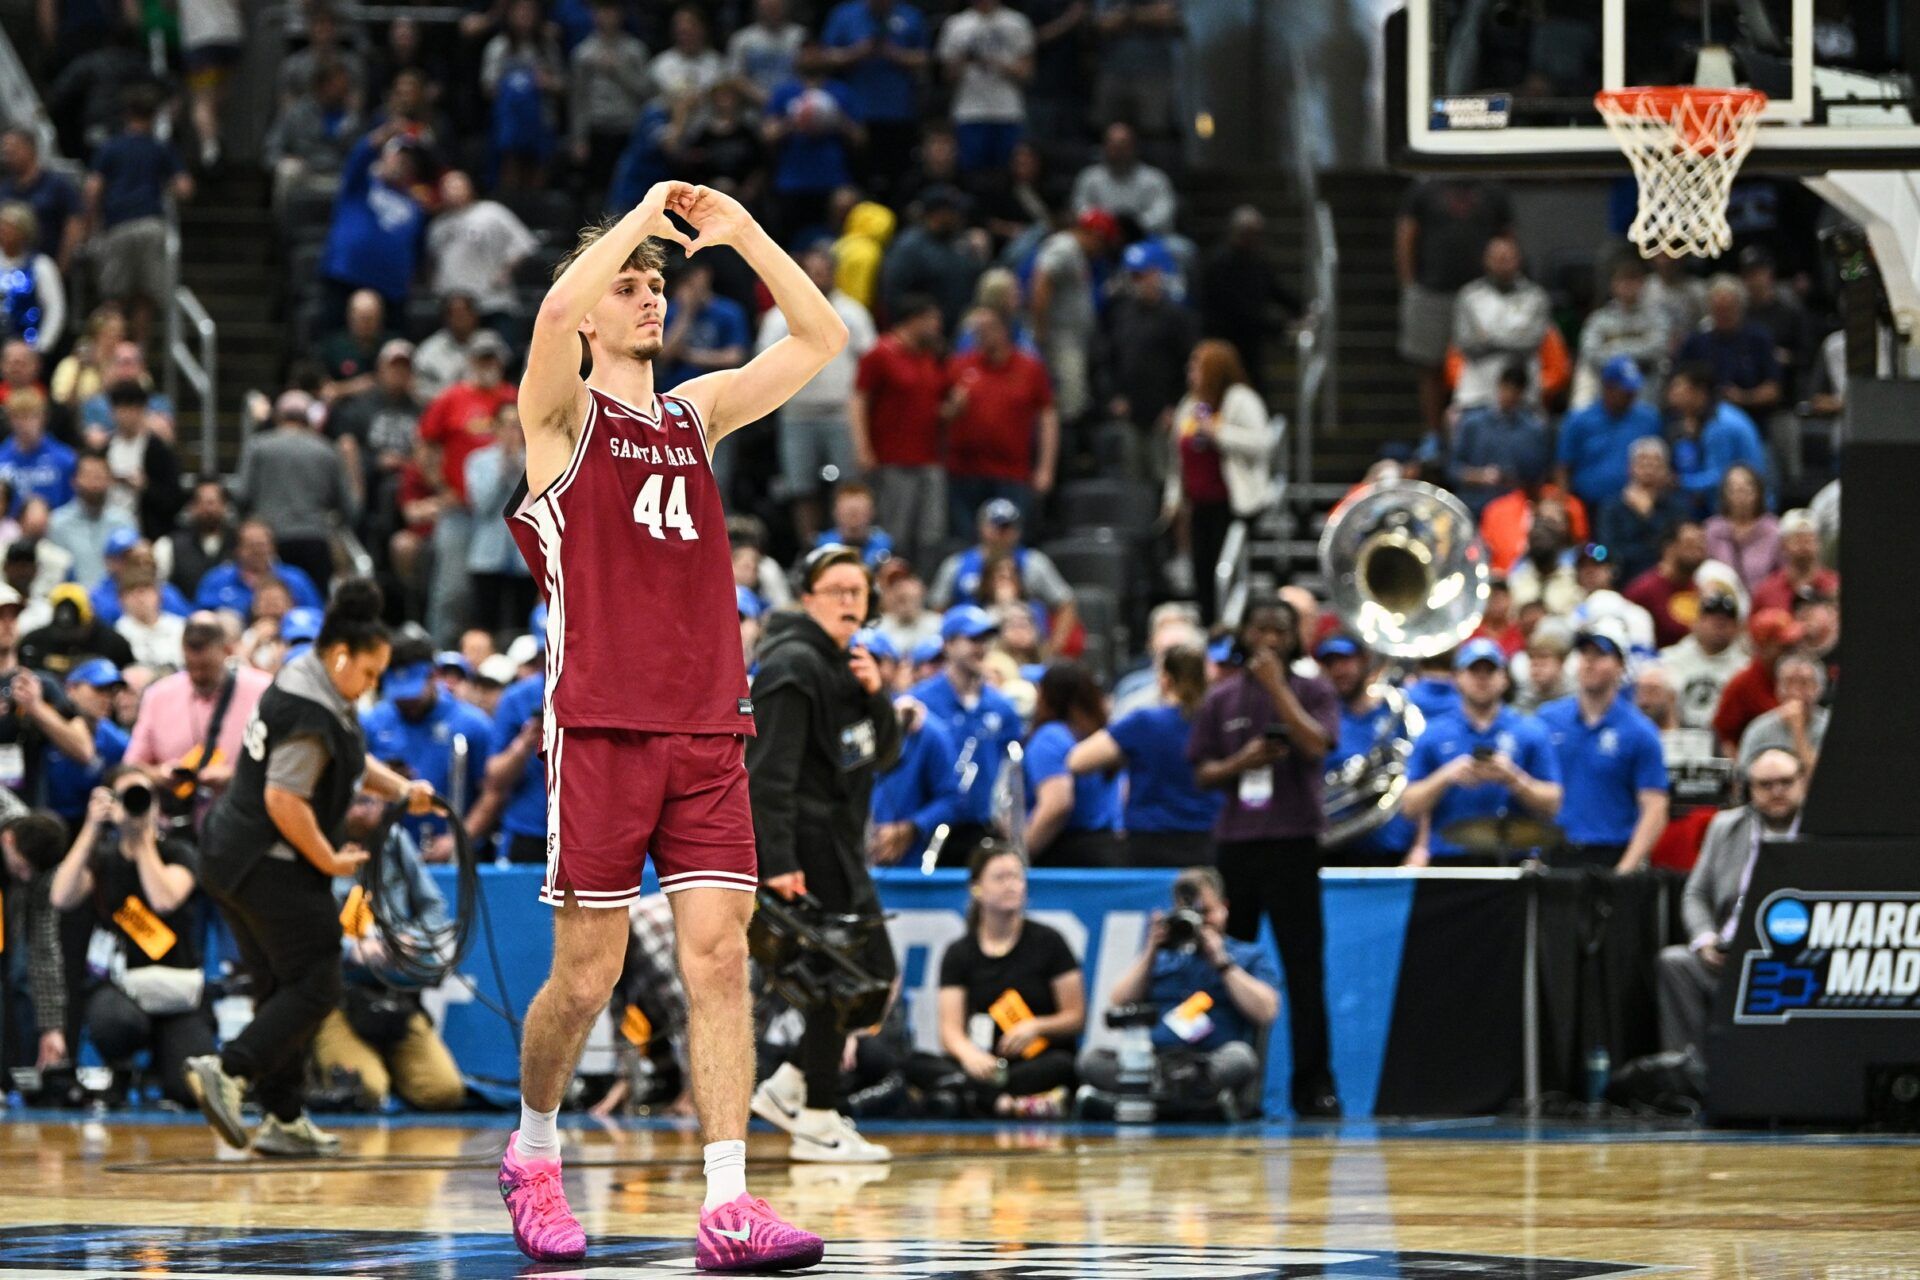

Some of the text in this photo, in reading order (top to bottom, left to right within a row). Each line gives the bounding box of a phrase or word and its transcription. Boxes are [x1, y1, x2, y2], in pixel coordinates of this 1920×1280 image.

[610, 437, 663, 465] SANTA
[633, 474, 699, 540] 44
[1825, 949, 1920, 996] MAD
